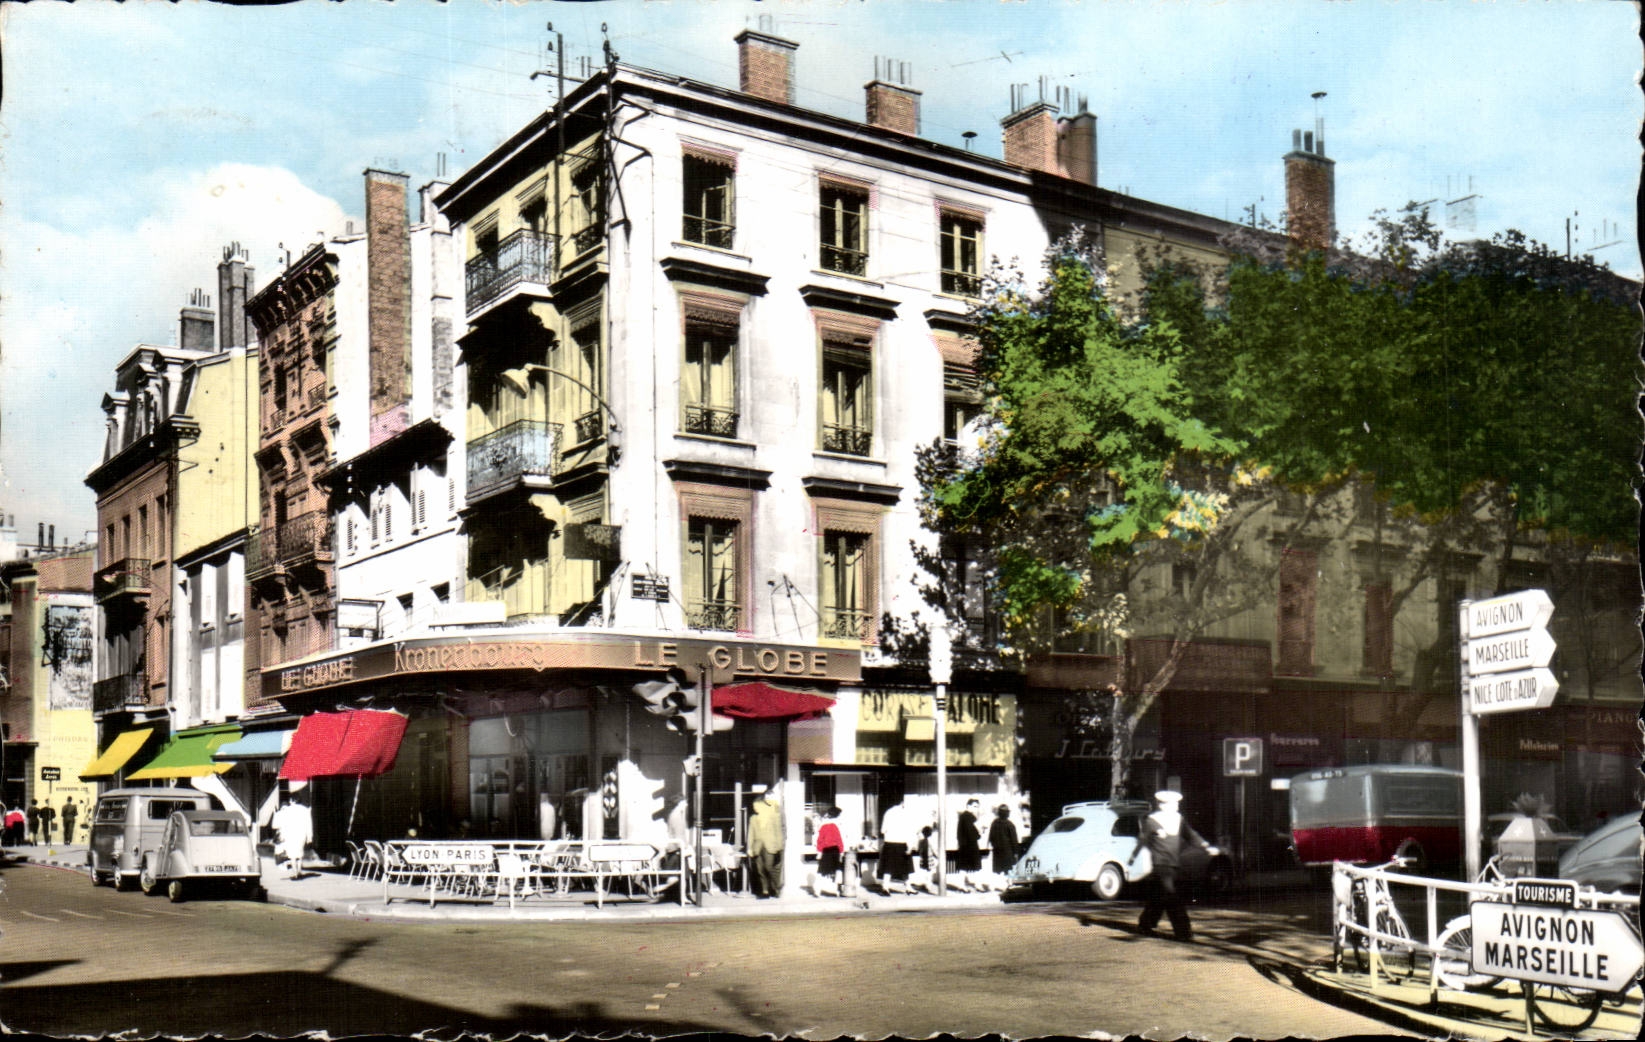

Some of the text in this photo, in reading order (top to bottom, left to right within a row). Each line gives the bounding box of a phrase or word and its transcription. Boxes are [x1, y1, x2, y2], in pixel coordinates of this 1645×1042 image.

[1476, 602, 1523, 627] AVIGNON
[634, 641, 828, 676] LE GLOBE
[1475, 638, 1529, 664] MARSEILLE
[281, 667, 301, 690] LE
[1474, 684, 1492, 704] NICE
[1235, 742, 1251, 770] P
[410, 849, 486, 861] LYON PARIS
[1517, 885, 1573, 904] TOURISME
[1500, 912, 1594, 946] AVIGNON
[1485, 941, 1609, 981] MARSEILLE
